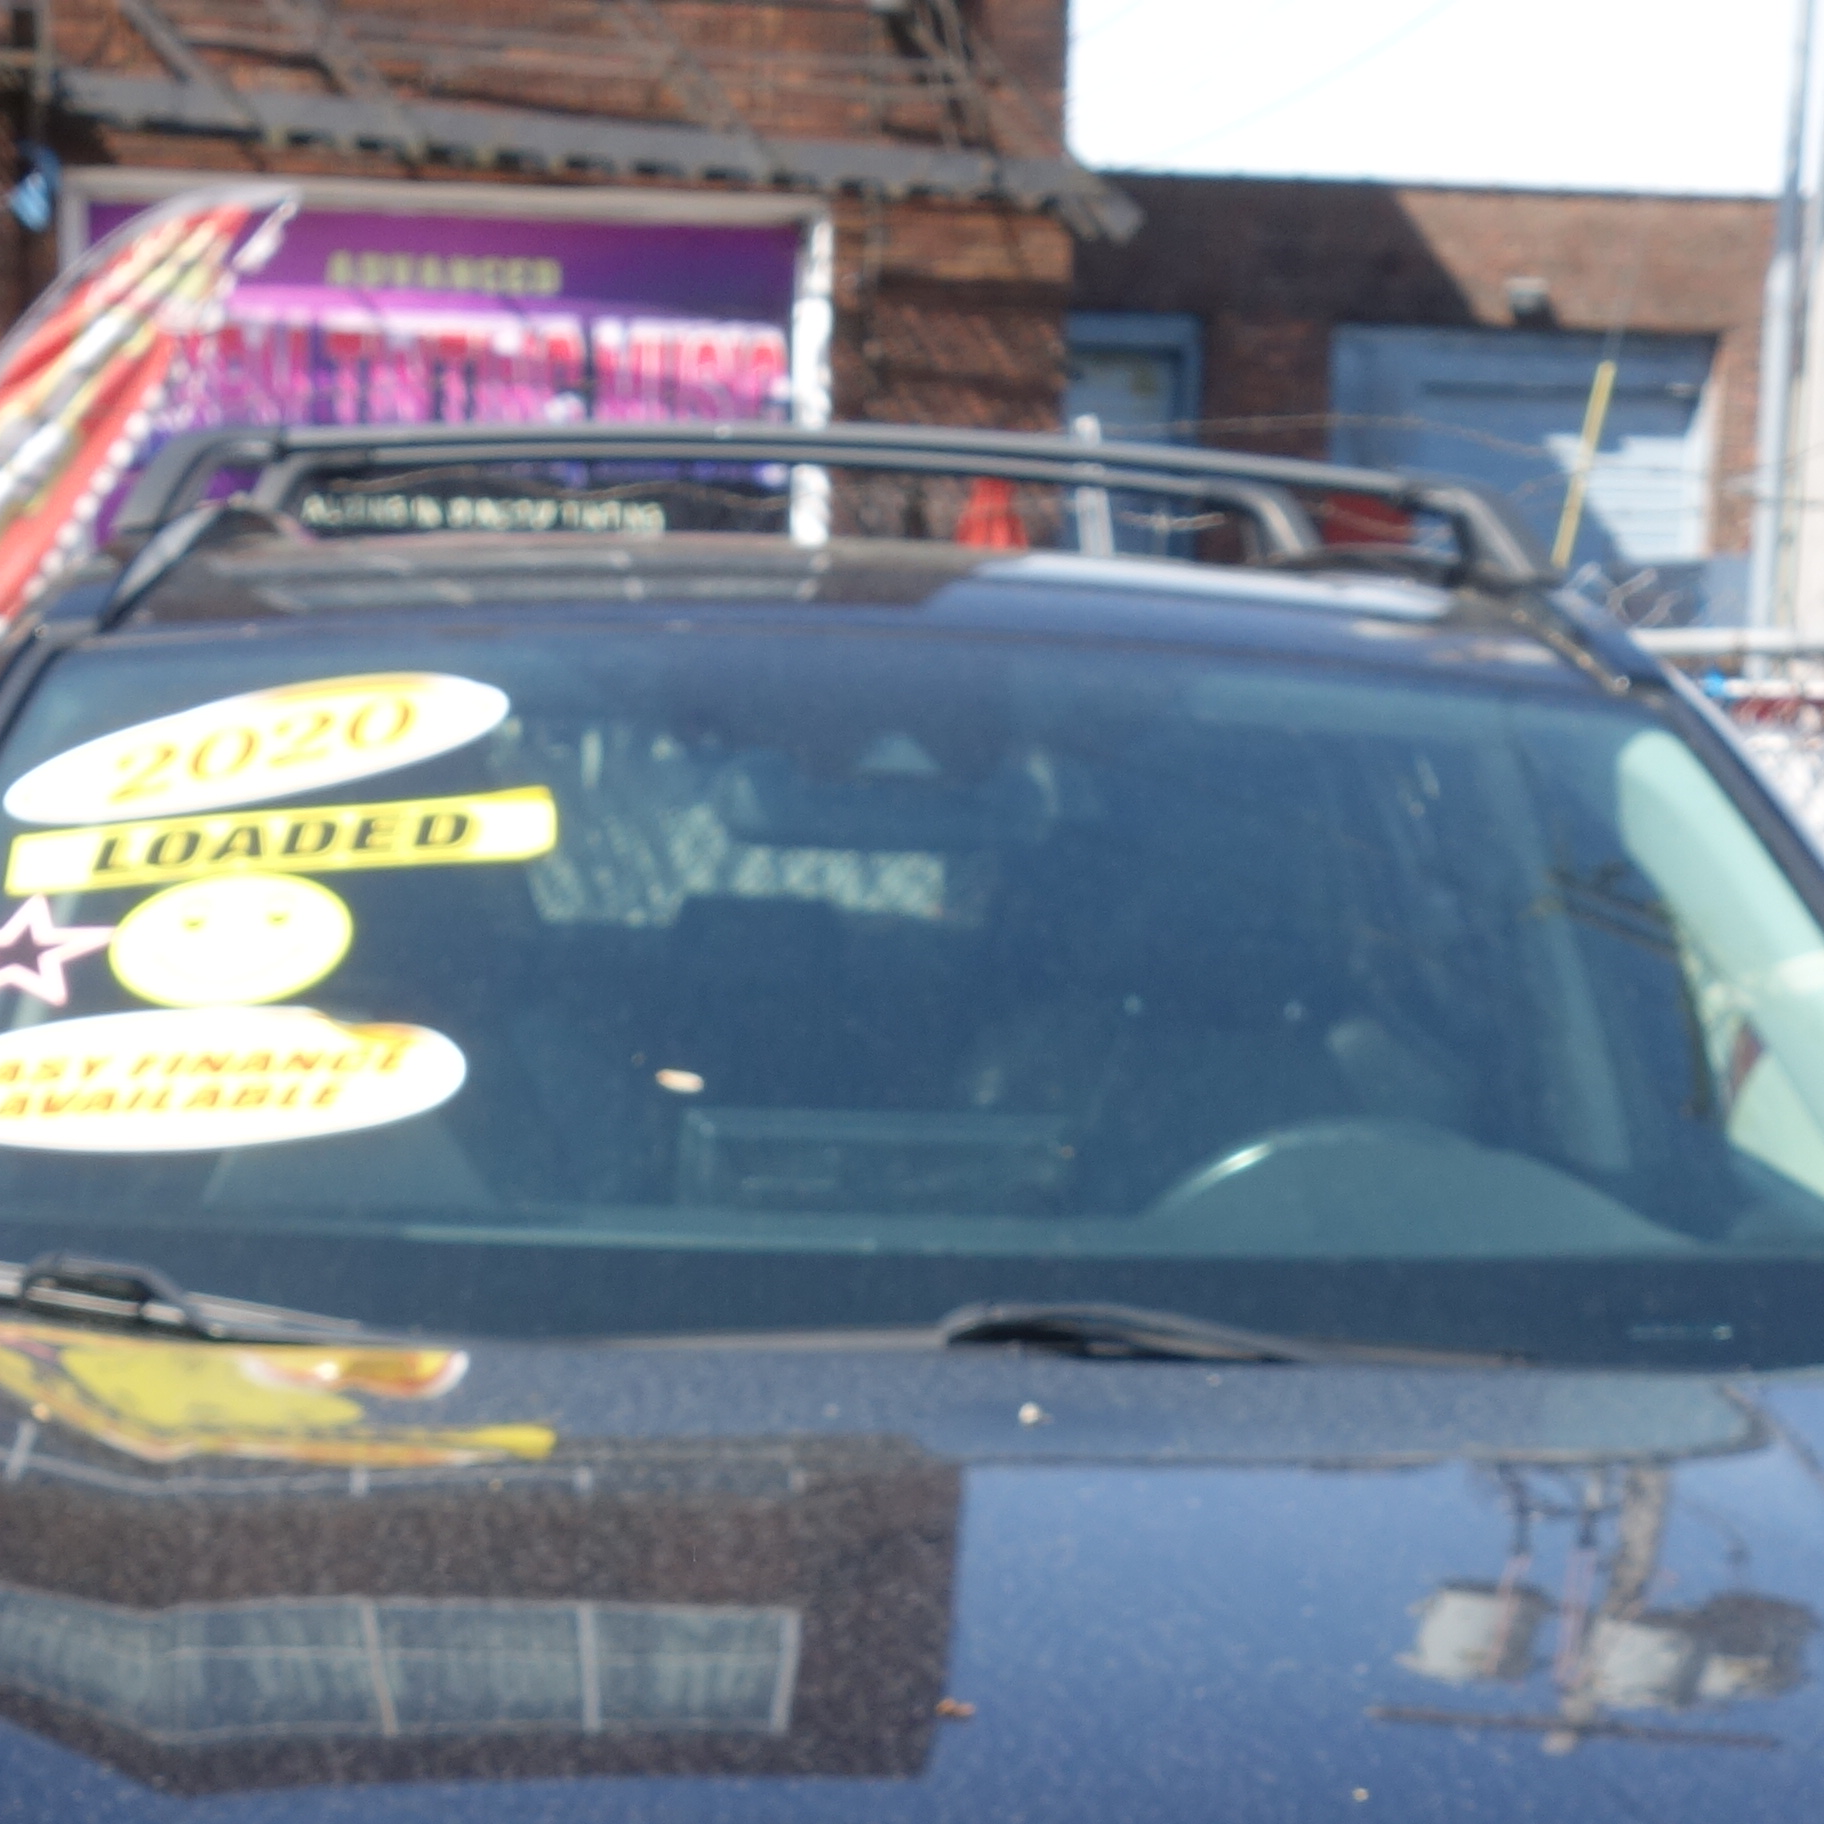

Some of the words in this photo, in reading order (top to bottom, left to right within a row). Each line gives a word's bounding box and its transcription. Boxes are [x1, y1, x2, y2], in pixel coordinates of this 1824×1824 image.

[326, 250, 563, 296] ADVANCED
[109, 696, 417, 803] 2020
[93, 812, 472, 873] LOADED
